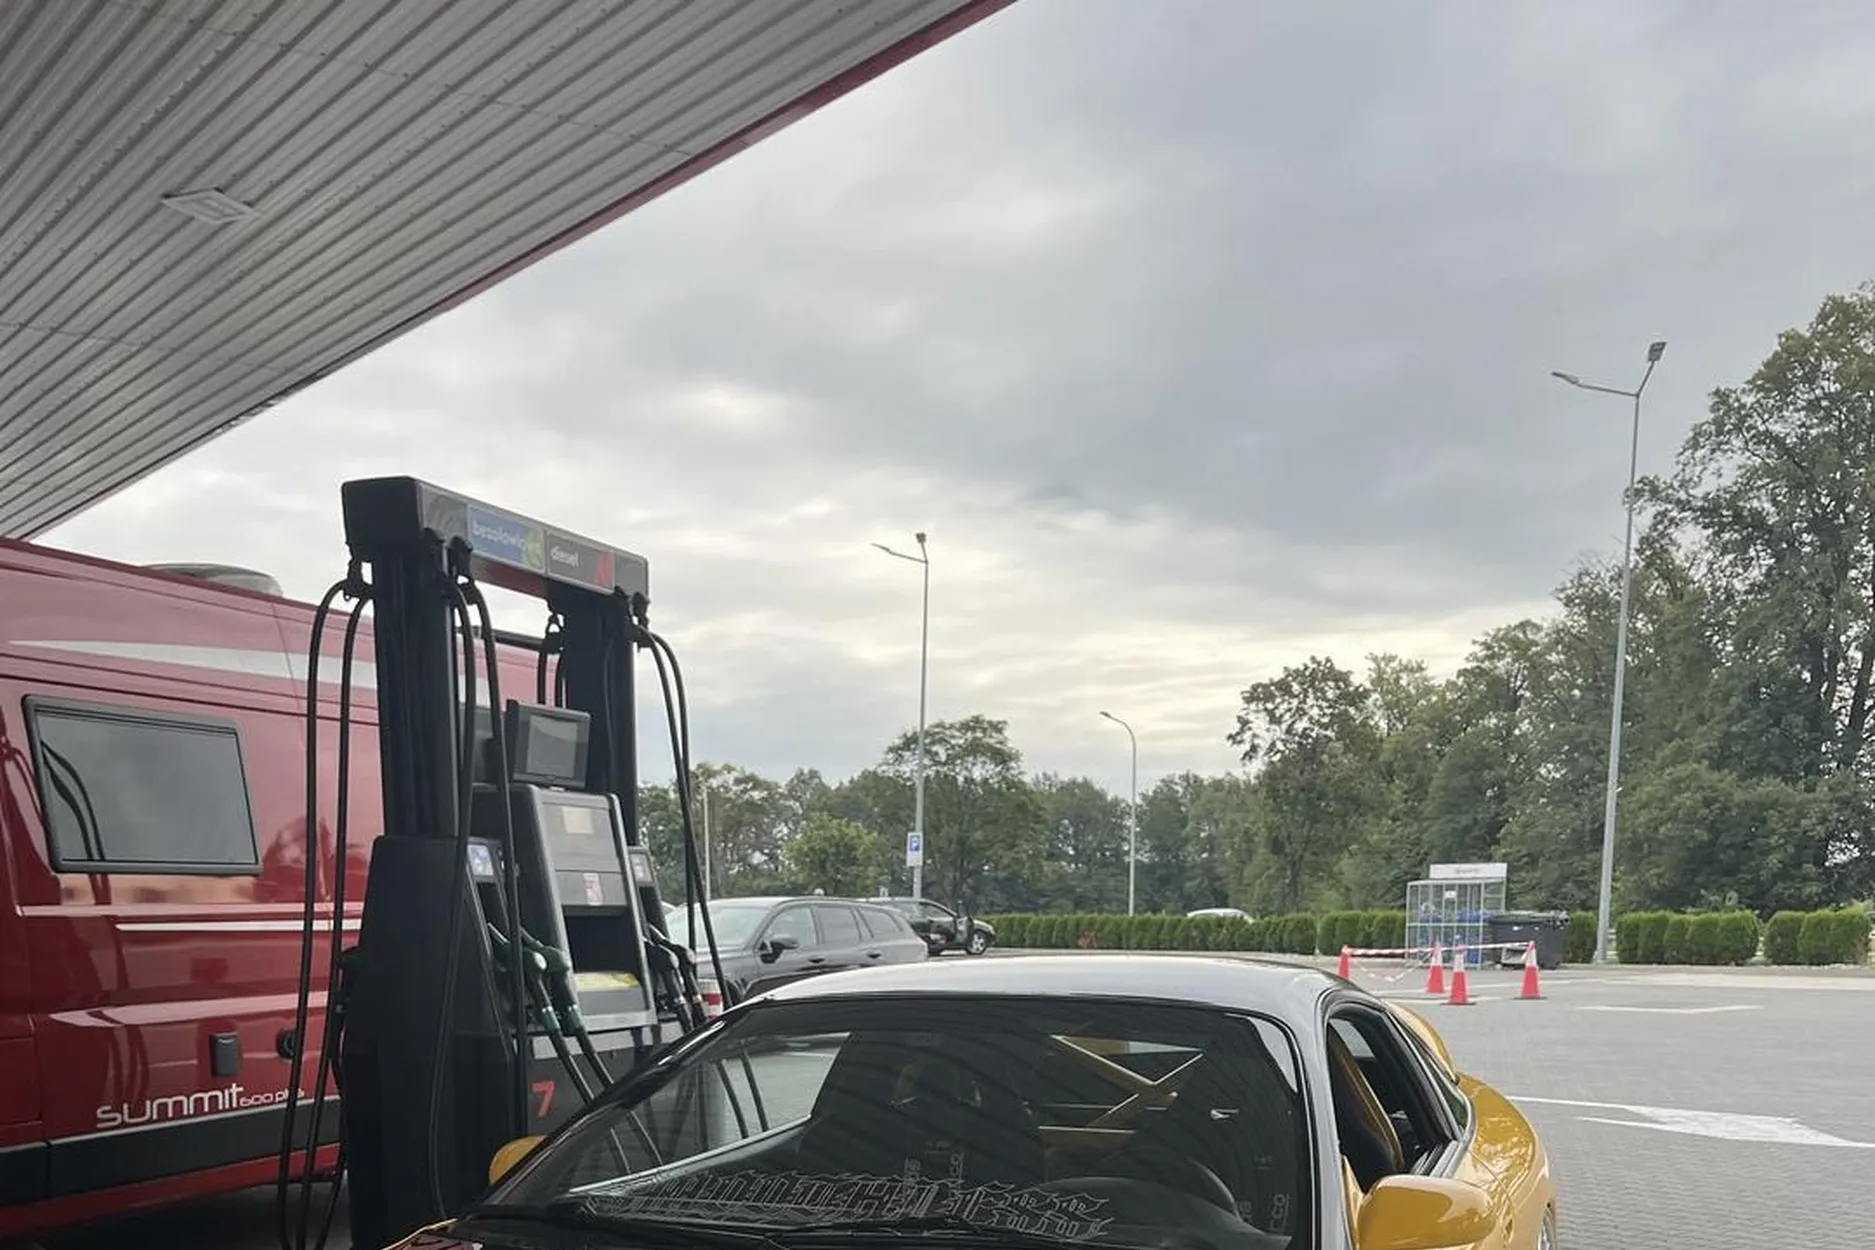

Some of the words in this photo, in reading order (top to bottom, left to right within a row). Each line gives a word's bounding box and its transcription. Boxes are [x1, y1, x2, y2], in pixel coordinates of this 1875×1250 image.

[96, 1083, 244, 1129] summit
[275, 1087, 305, 1103] pls
[531, 1081, 555, 1118] 7
